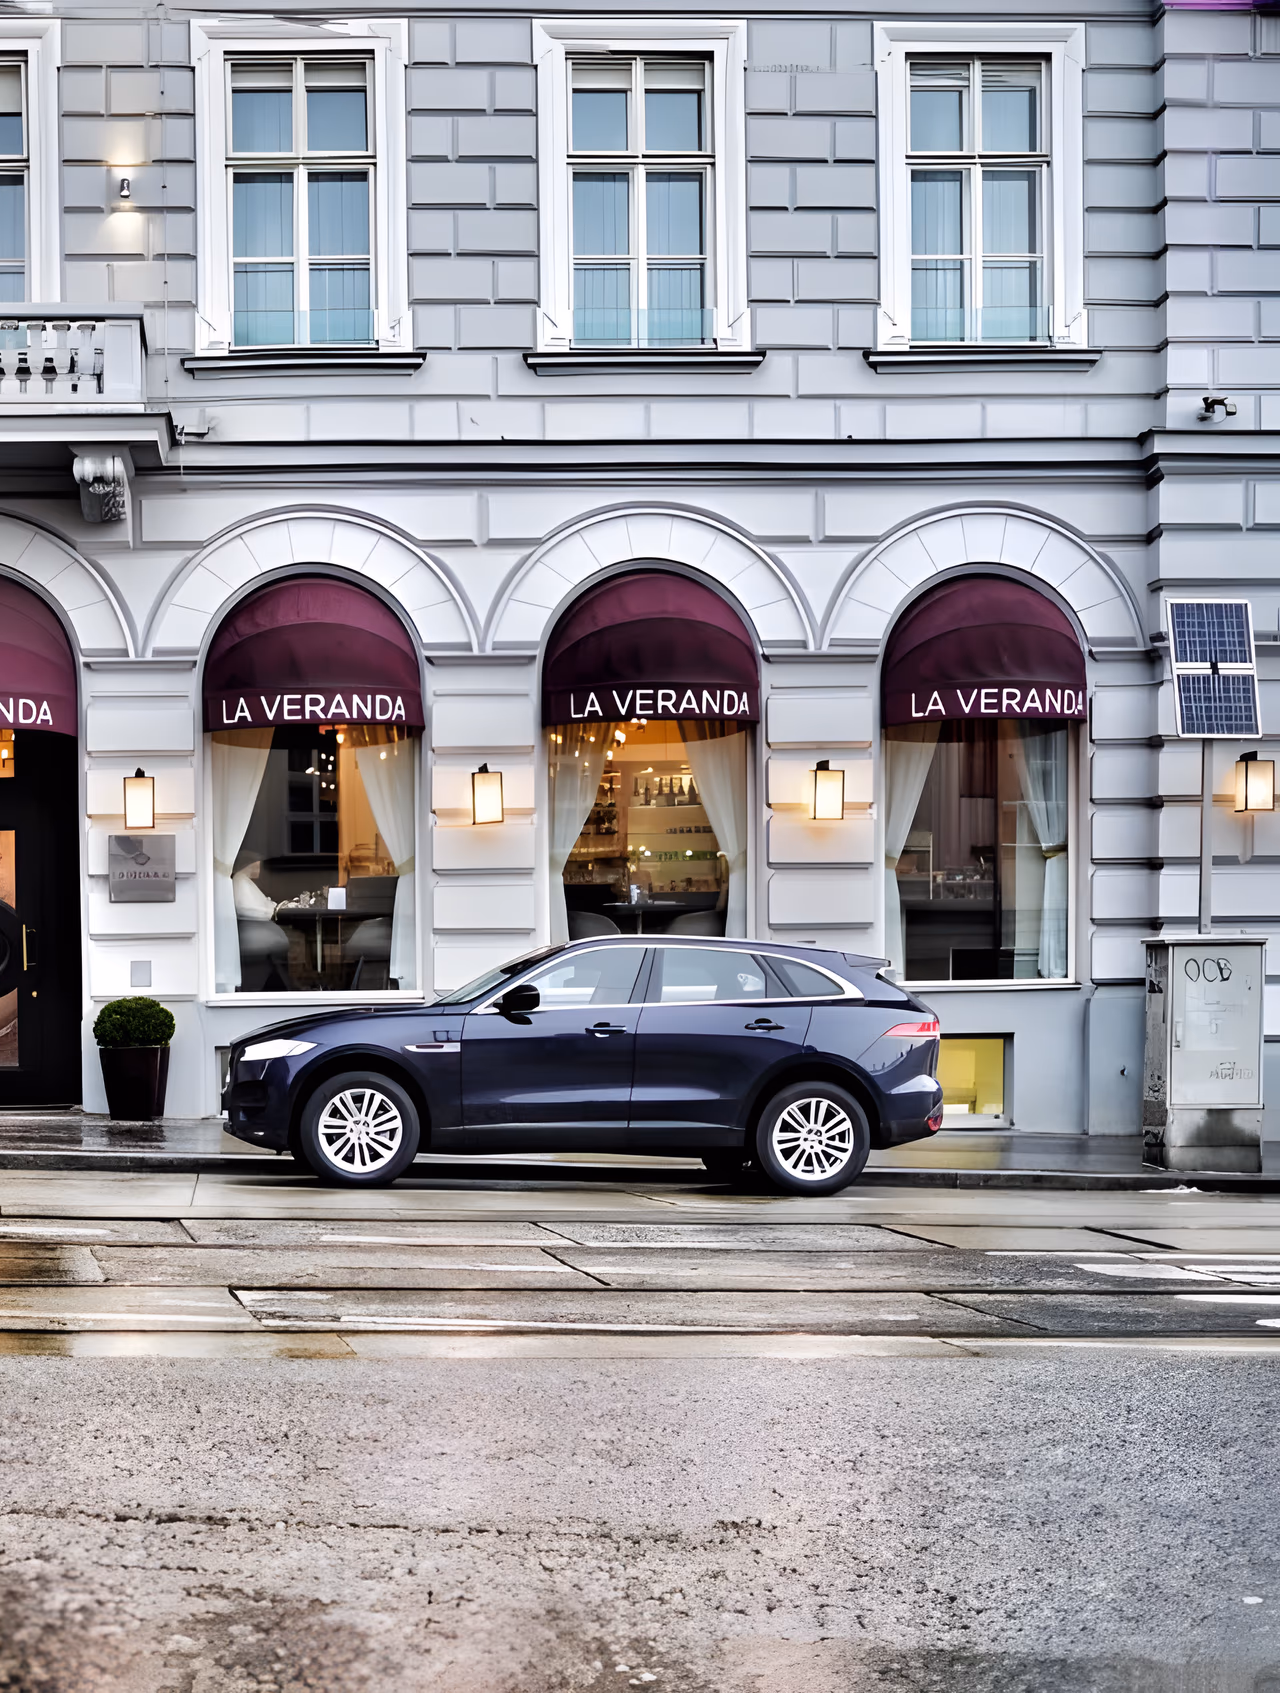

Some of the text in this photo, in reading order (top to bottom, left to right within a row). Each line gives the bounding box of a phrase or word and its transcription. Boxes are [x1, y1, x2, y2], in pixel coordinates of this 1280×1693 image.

[221, 693, 406, 724] LA VERANDA
[570, 688, 749, 718] LA VERANDA
[912, 687, 1083, 717] LA VERANDA
